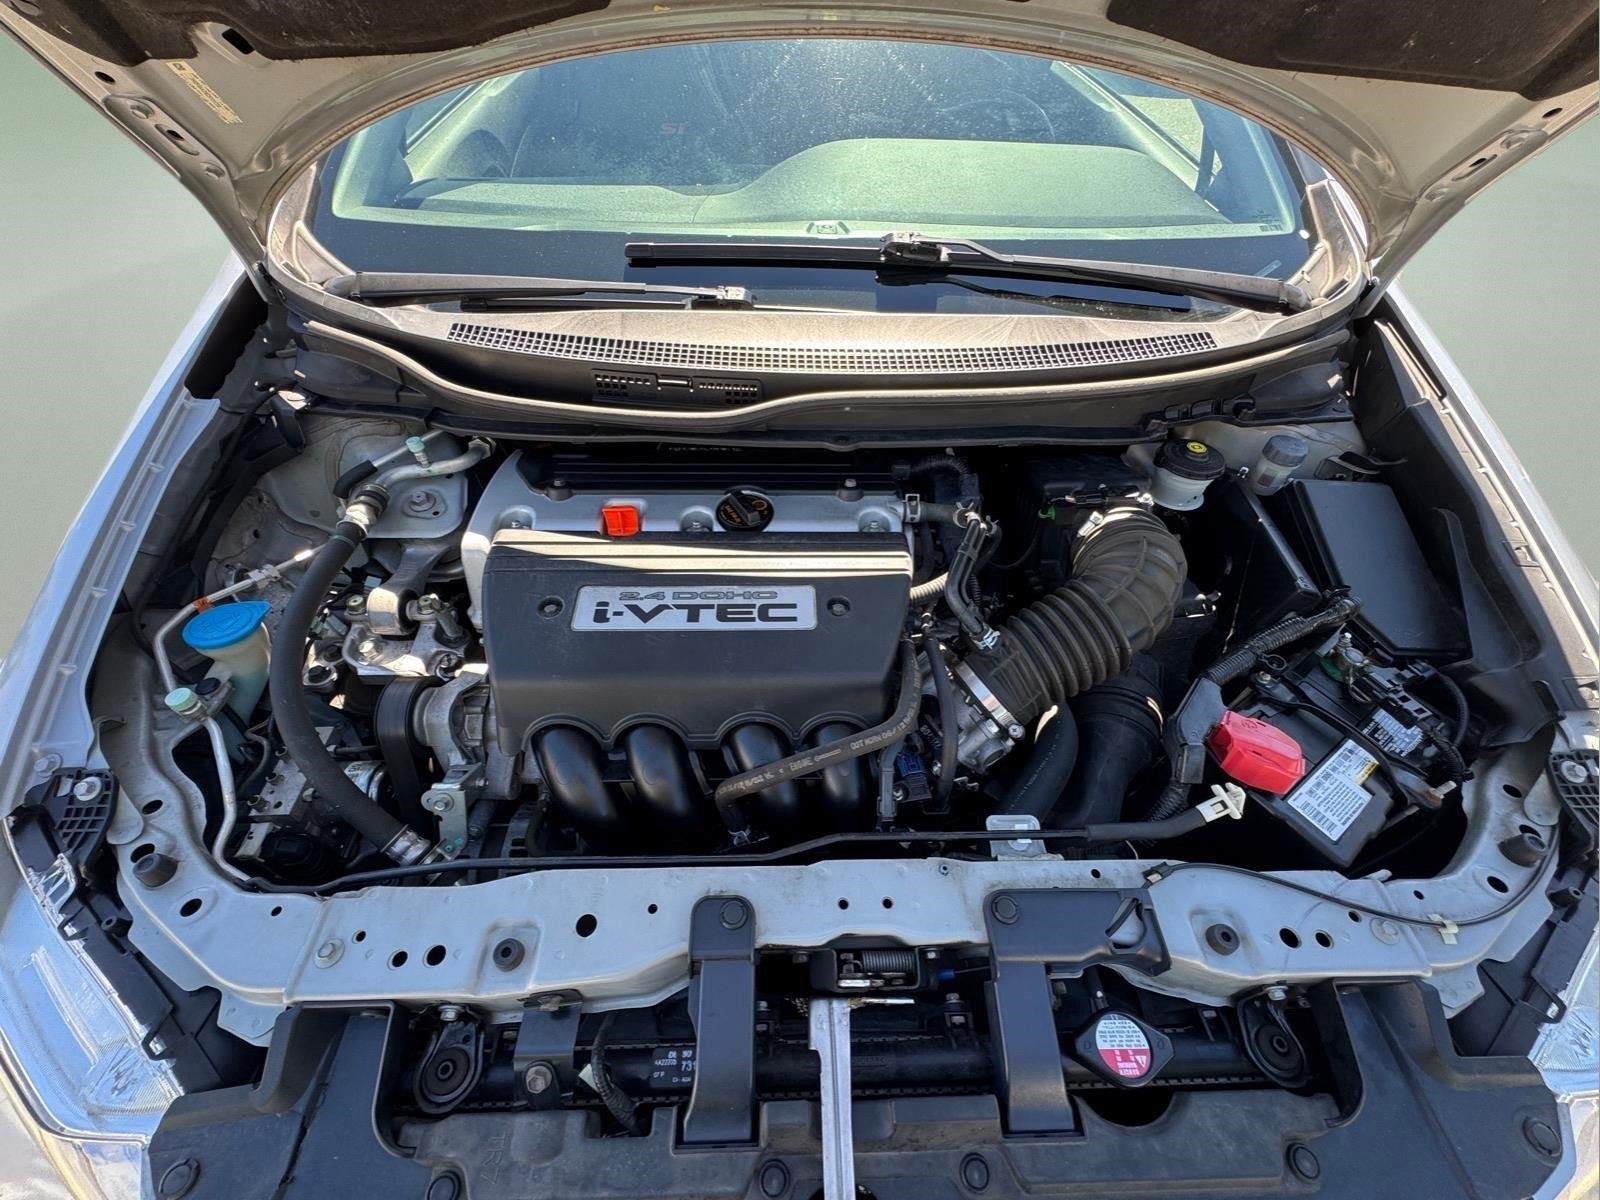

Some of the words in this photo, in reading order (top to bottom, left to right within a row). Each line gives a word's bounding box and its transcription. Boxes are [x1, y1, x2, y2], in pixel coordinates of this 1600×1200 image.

[619, 591, 666, 601] 2.4
[672, 590, 778, 600] DOHC
[593, 601, 798, 624] i-VTEC
